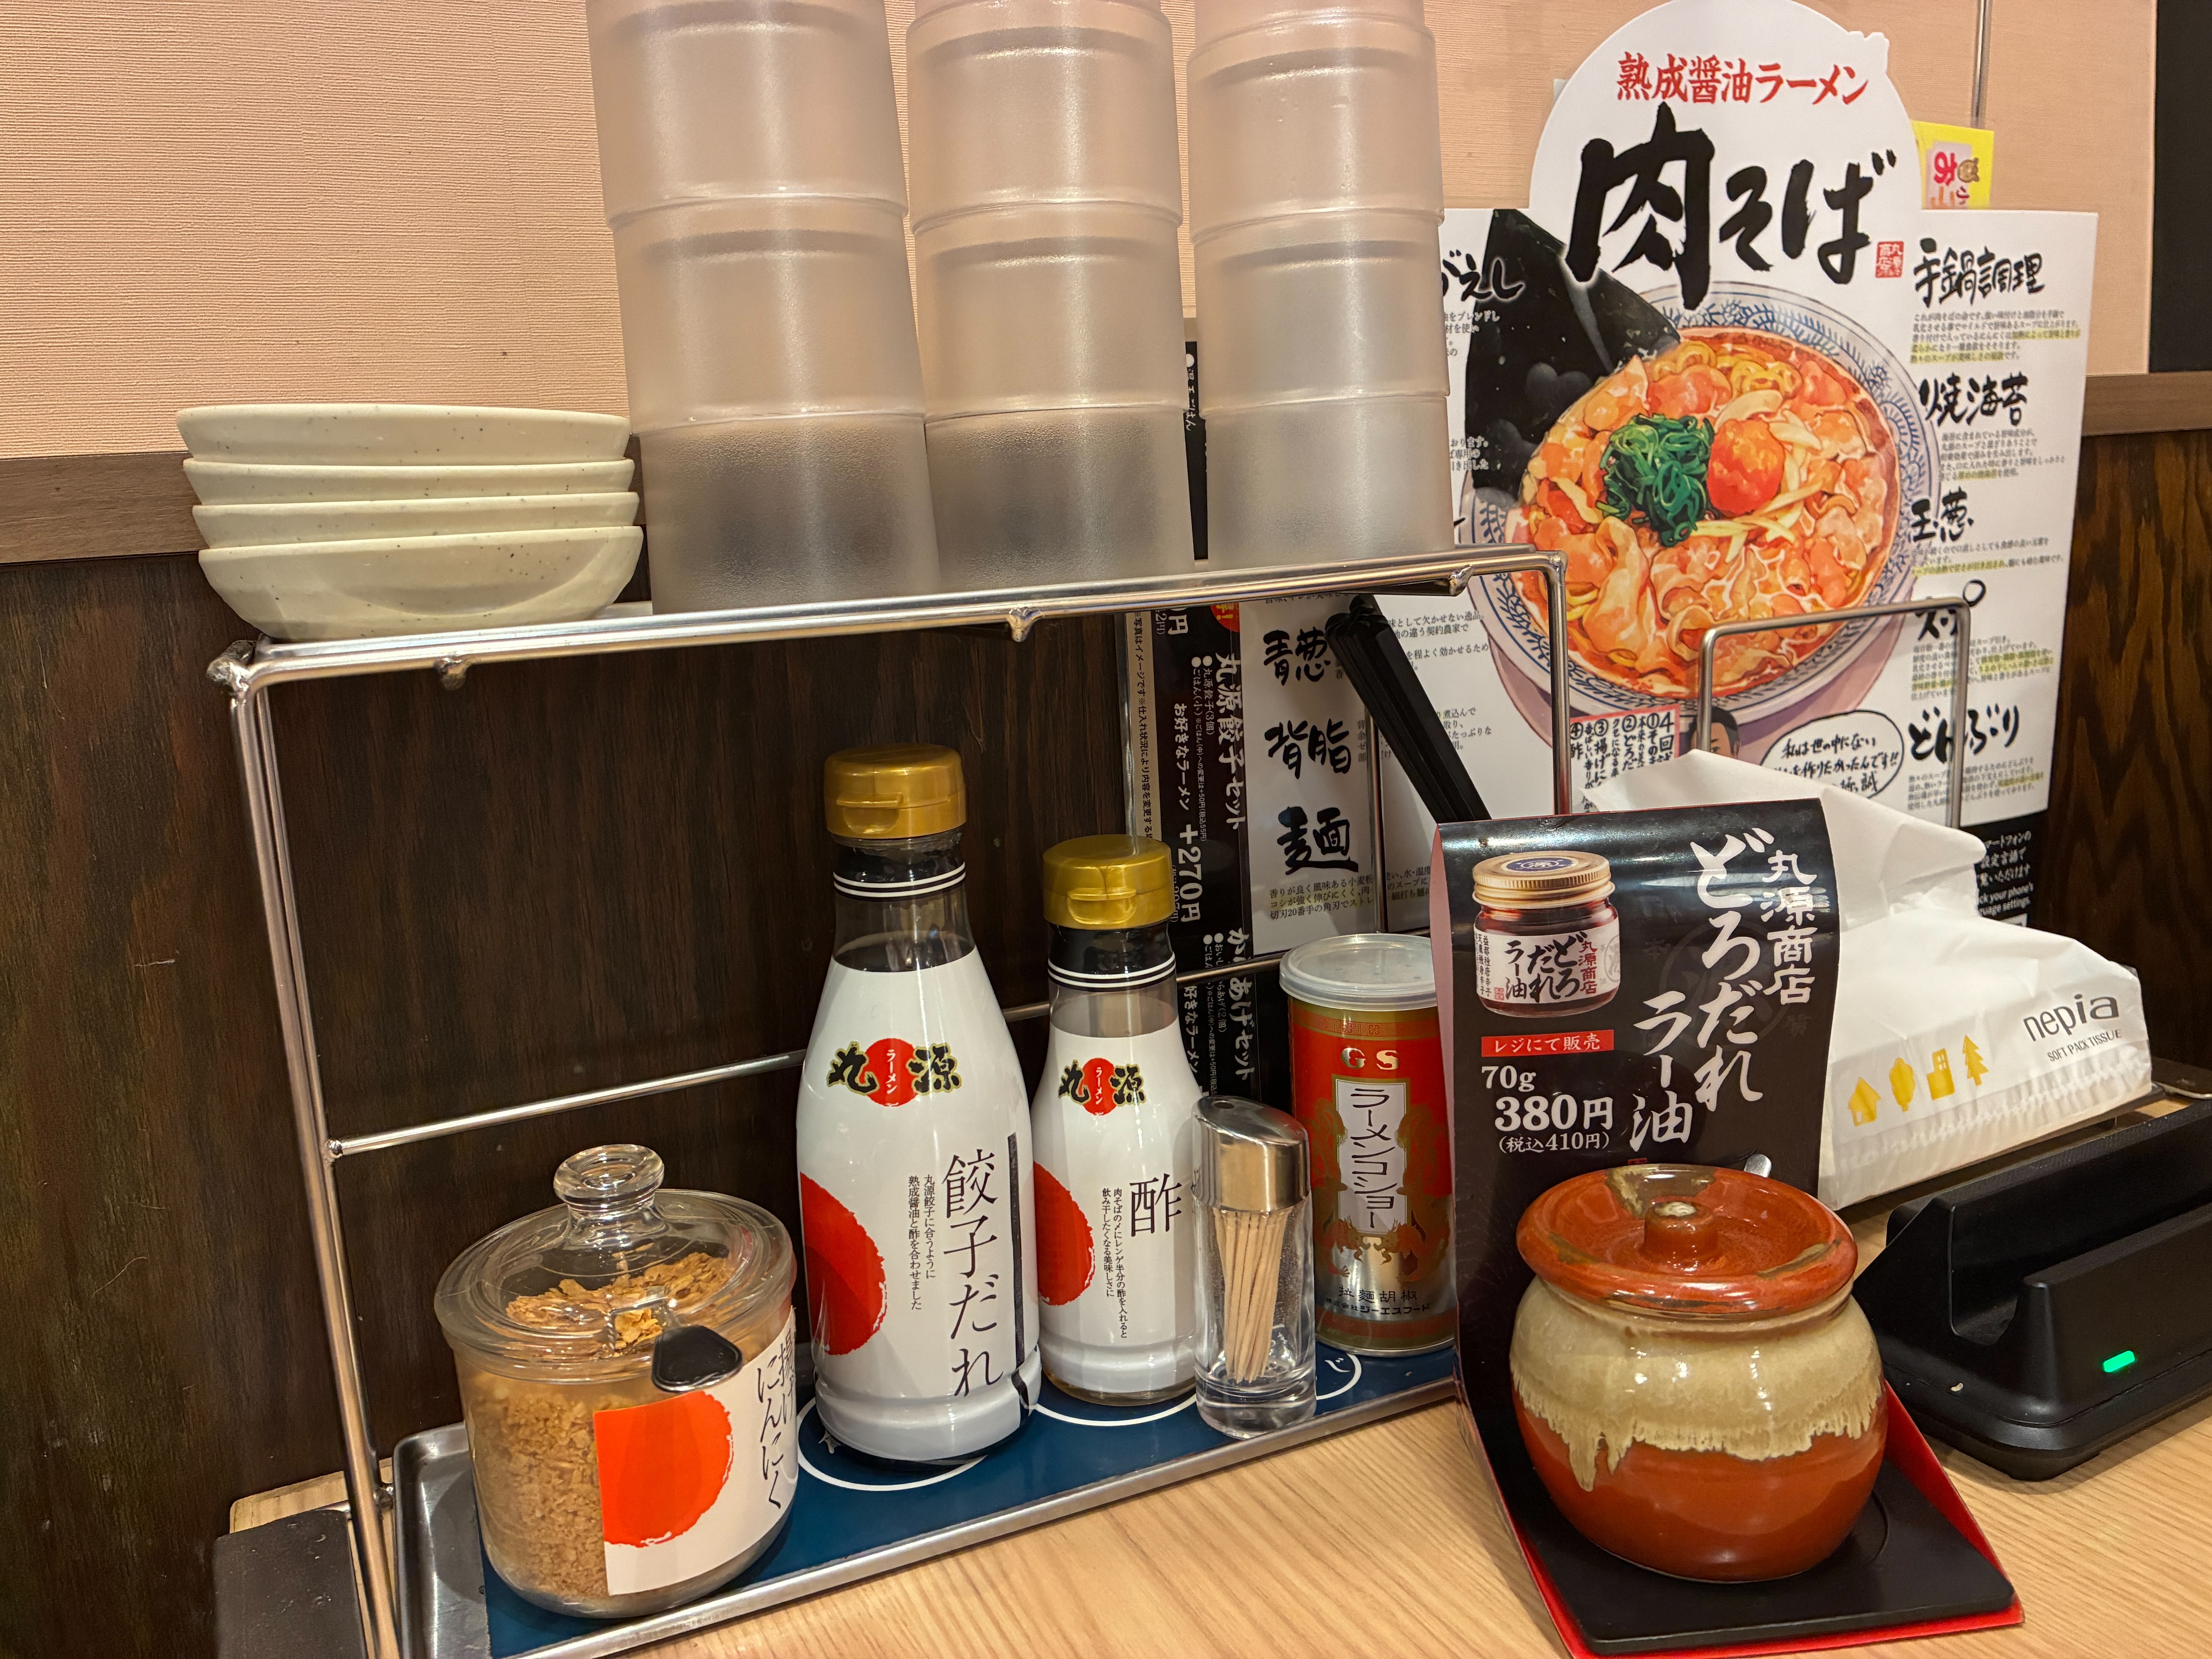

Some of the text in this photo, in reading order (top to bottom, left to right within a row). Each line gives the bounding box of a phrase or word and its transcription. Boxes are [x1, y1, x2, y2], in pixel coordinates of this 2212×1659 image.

[1616, 51, 1869, 105] 熟成醤油ラーメン
[1565, 101, 1897, 311] 肉そば
[1913, 237, 2045, 309] 手鍋調理
[1918, 371, 2029, 427] 焼海苔
[1167, 608, 1189, 635] 円
[1263, 626, 1331, 686] 青葱
[1174, 702, 1191, 811] お好きなラーメン
[1215, 652, 1246, 830] 丸源餃子セット
[1264, 718, 1352, 780] 背脂
[1178, 823, 1203, 923] +270円
[1760, 850, 1817, 1005] 丸源商店
[1504, 940, 1527, 1000] ラー油
[1578, 941, 1598, 994] 丸源商店
[1690, 827, 1774, 1113] どろだれ
[1183, 985, 1199, 1074] 好きなラーメン
[1494, 1034, 1601, 1053] レジにて販売
[2023, 993, 2119, 1042] nepia
[2047, 1029, 2123, 1062] SOFT PACK TISSUE
[885, 1049, 898, 1095] ラーメン
[1095, 1066, 1104, 1105] ラーメン
[1340, 1047, 1400, 1070] GS
[1481, 1066, 1537, 1092] 70g
[1628, 990, 1694, 1152] ラー油
[1494, 1094, 1614, 1133] 380円
[1499, 1132, 1610, 1153] (税込410円)
[1350, 1087, 1398, 1229] ラーメンコショー
[924, 1174, 936, 1279] 丸源餃子に合うように
[1129, 1173, 1183, 1238] 酢
[908, 1175, 922, 1310] 熟成醤油と酢を合わせました
[941, 1148, 1004, 1397] 餃子だれ
[1101, 1187, 1115, 1297] 飲み干したくなる美味しさに
[757, 1354, 783, 1509] にんにく
